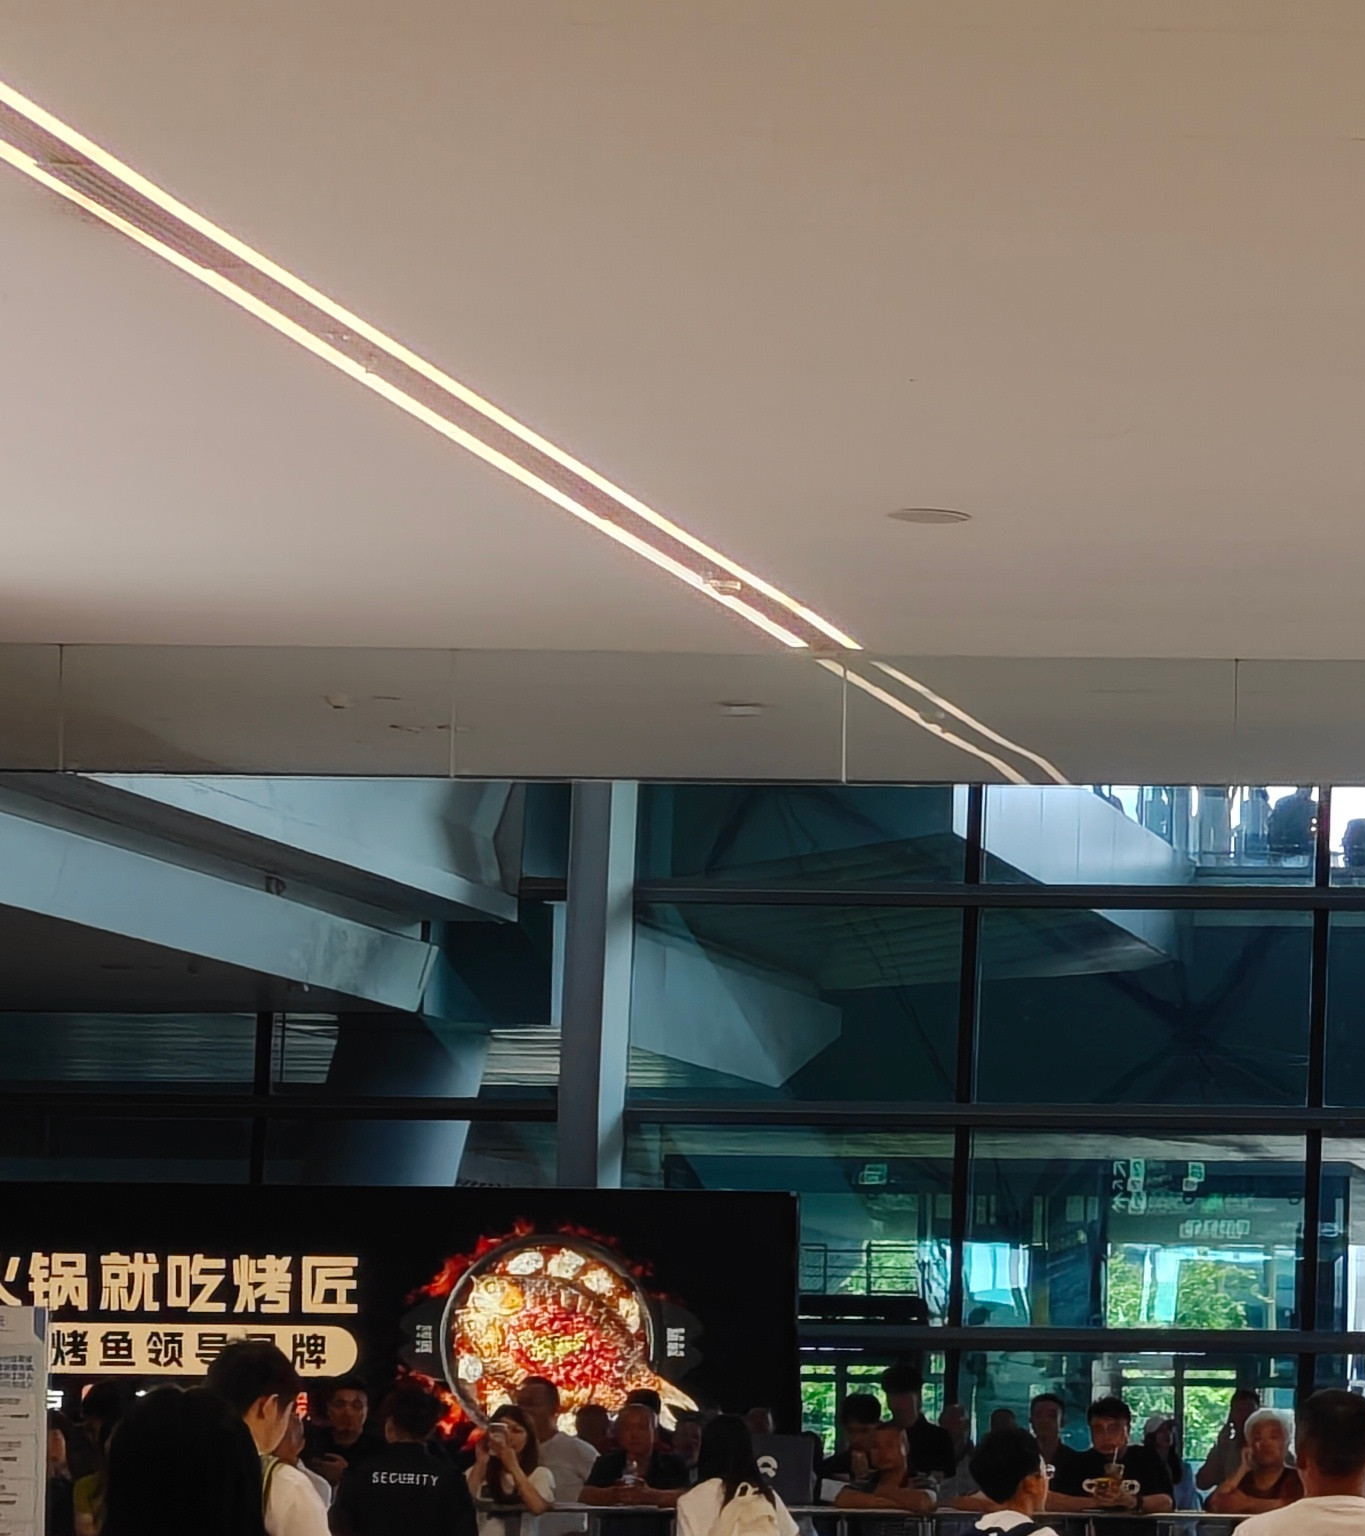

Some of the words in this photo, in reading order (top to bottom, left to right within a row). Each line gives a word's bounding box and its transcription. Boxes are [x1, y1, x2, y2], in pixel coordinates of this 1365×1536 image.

[51, 1330, 327, 1369] 烤鱼领导牌
[372, 1471, 438, 1486] SECURITY
